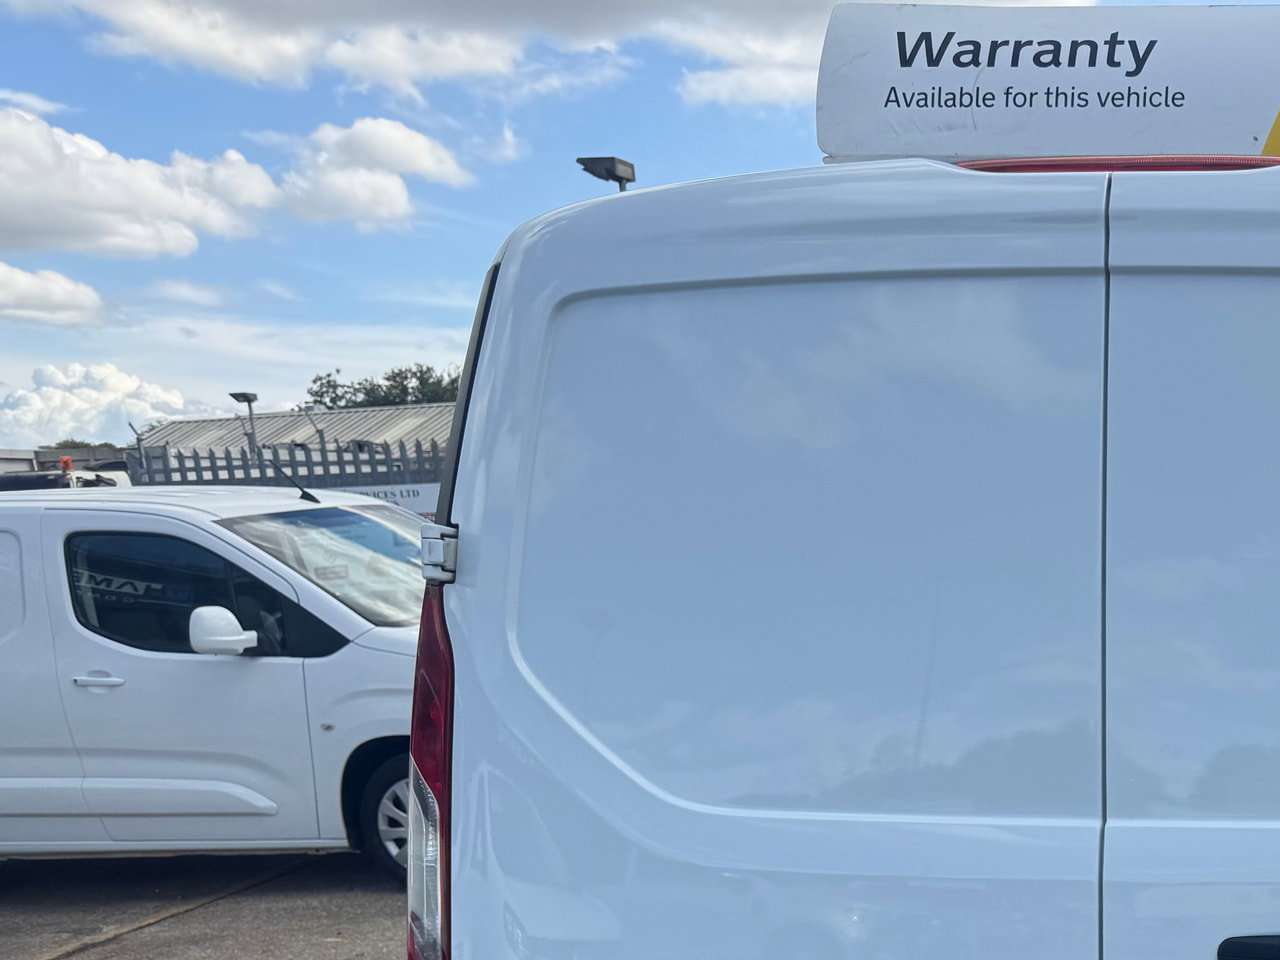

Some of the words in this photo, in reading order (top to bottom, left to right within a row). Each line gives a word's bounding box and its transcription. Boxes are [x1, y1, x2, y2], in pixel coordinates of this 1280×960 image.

[896, 31, 1158, 77] Warranty
[884, 86, 996, 109] Available
[1003, 86, 1038, 109] for
[1044, 86, 1089, 109] this
[1096, 86, 1186, 109] vehicle
[400, 489, 420, 498] LTD
